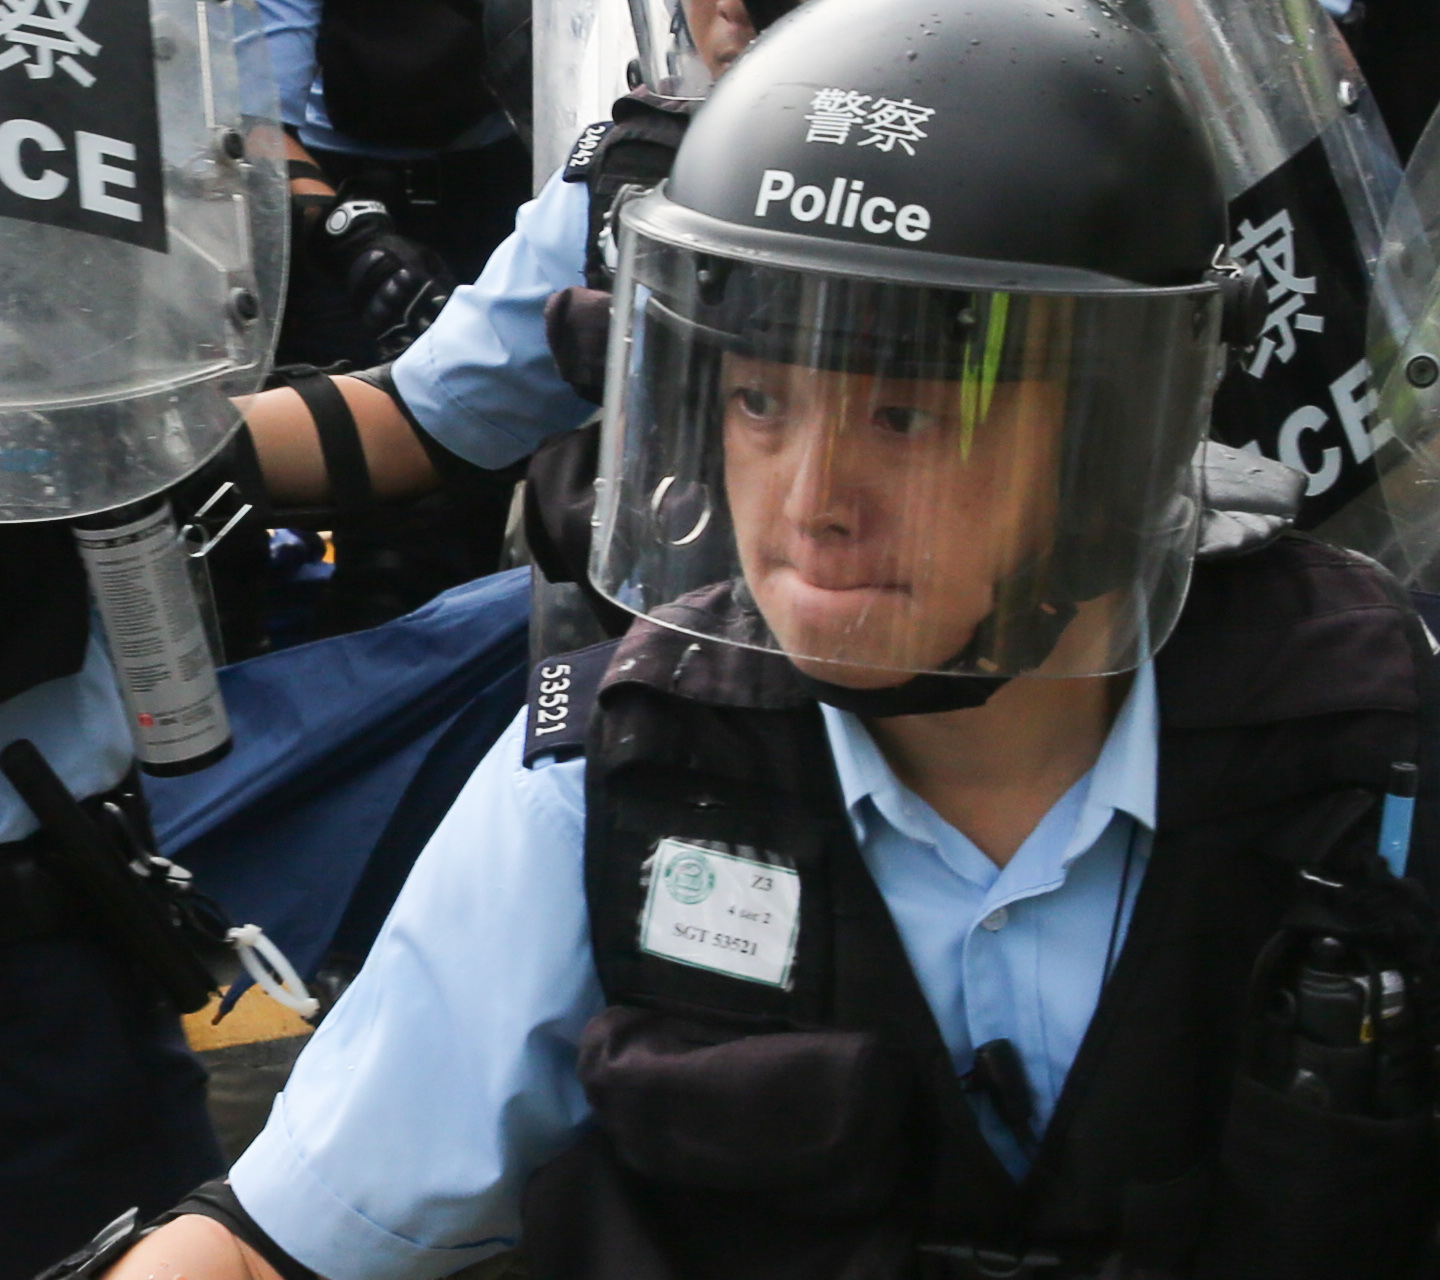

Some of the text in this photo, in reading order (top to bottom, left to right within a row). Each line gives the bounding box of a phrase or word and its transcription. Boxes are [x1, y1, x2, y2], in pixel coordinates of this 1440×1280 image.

[804, 87, 936, 156] 警察
[754, 169, 931, 241] Police
[535, 664, 571, 736] 53521
[750, 873, 773, 892] Z3
[674, 921, 758, 957] SGT 53521
